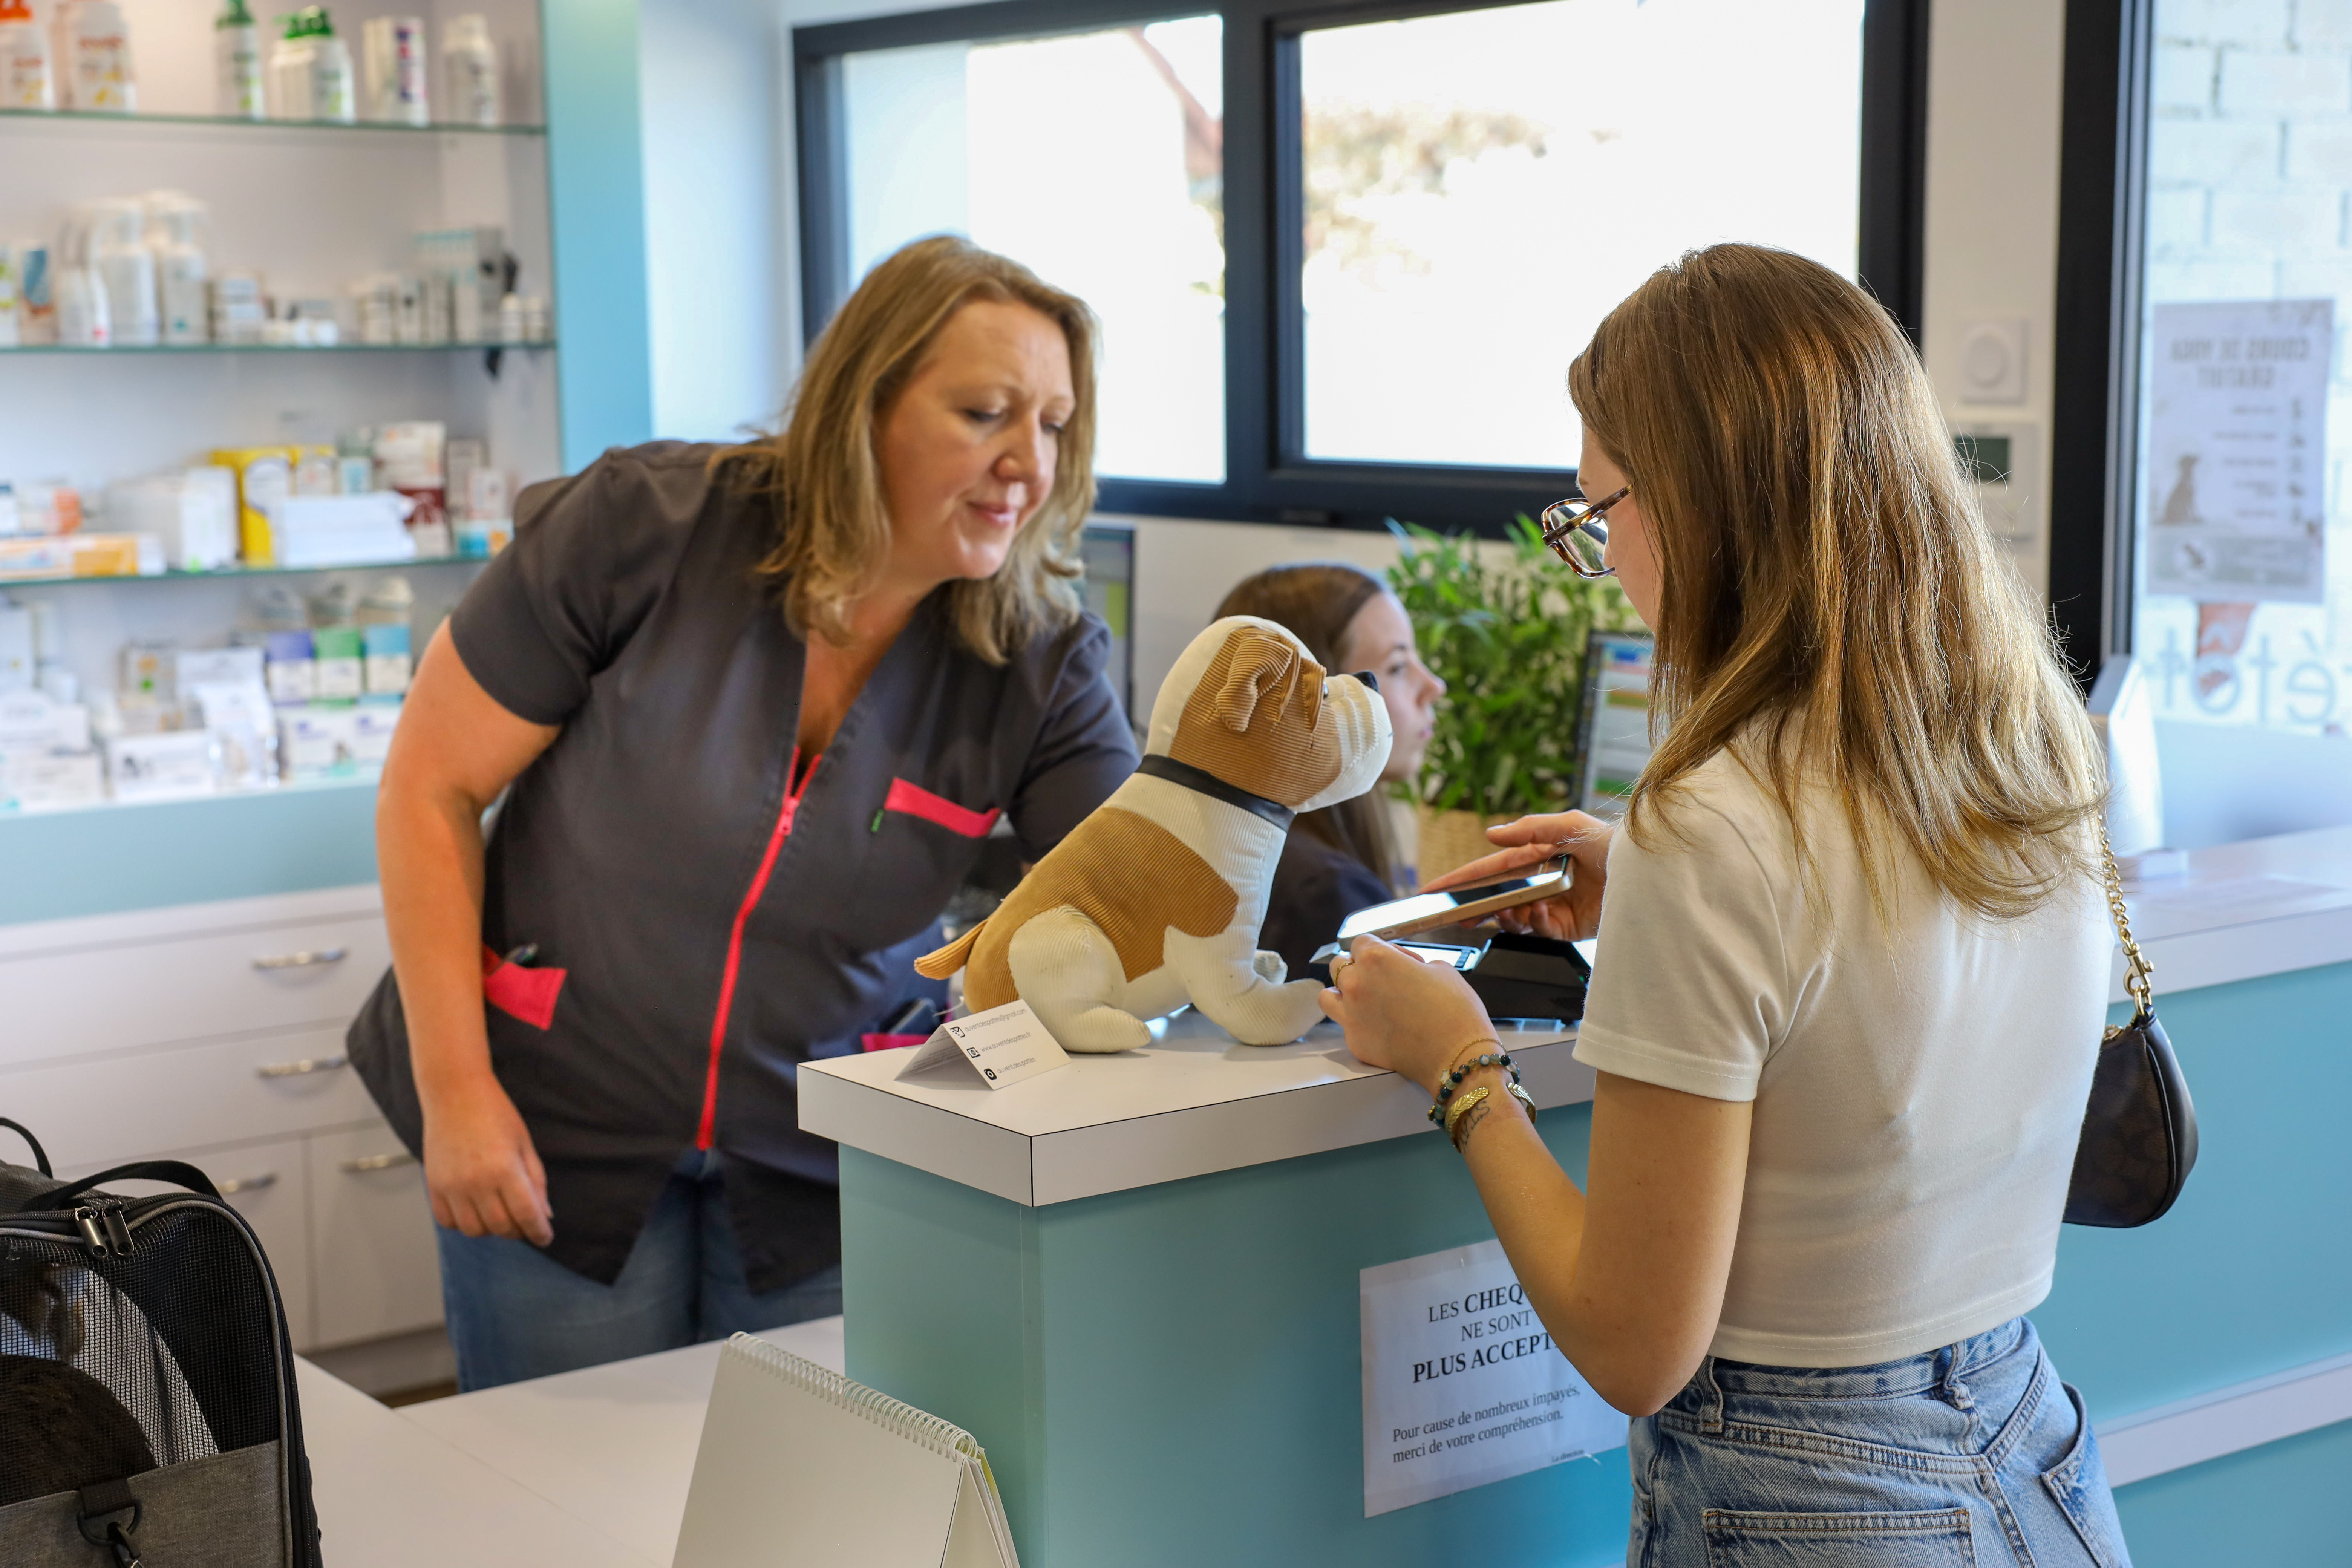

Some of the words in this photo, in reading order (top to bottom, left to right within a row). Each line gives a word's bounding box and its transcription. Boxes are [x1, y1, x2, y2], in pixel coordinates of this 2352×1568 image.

[1429, 1301, 1459, 1323] LES
[1464, 1283, 1523, 1313] CHEQ
[1461, 1321, 1484, 1341] NE
[1488, 1309, 1532, 1335] SONT
[1413, 1352, 1466, 1383] PLUS
[1471, 1332, 1557, 1369] ACCEPT
[1393, 1427, 1420, 1442] Pour
[1423, 1418, 1455, 1434] cause
[1458, 1411, 1472, 1426] de
[1475, 1401, 1530, 1421] nombreux
[1533, 1383, 1581, 1406] impayés,
[1393, 1442, 1426, 1463] merci
[1429, 1439, 1443, 1453] de
[1446, 1433, 1475, 1449] votre
[1478, 1410, 1563, 1438] compréhension.
